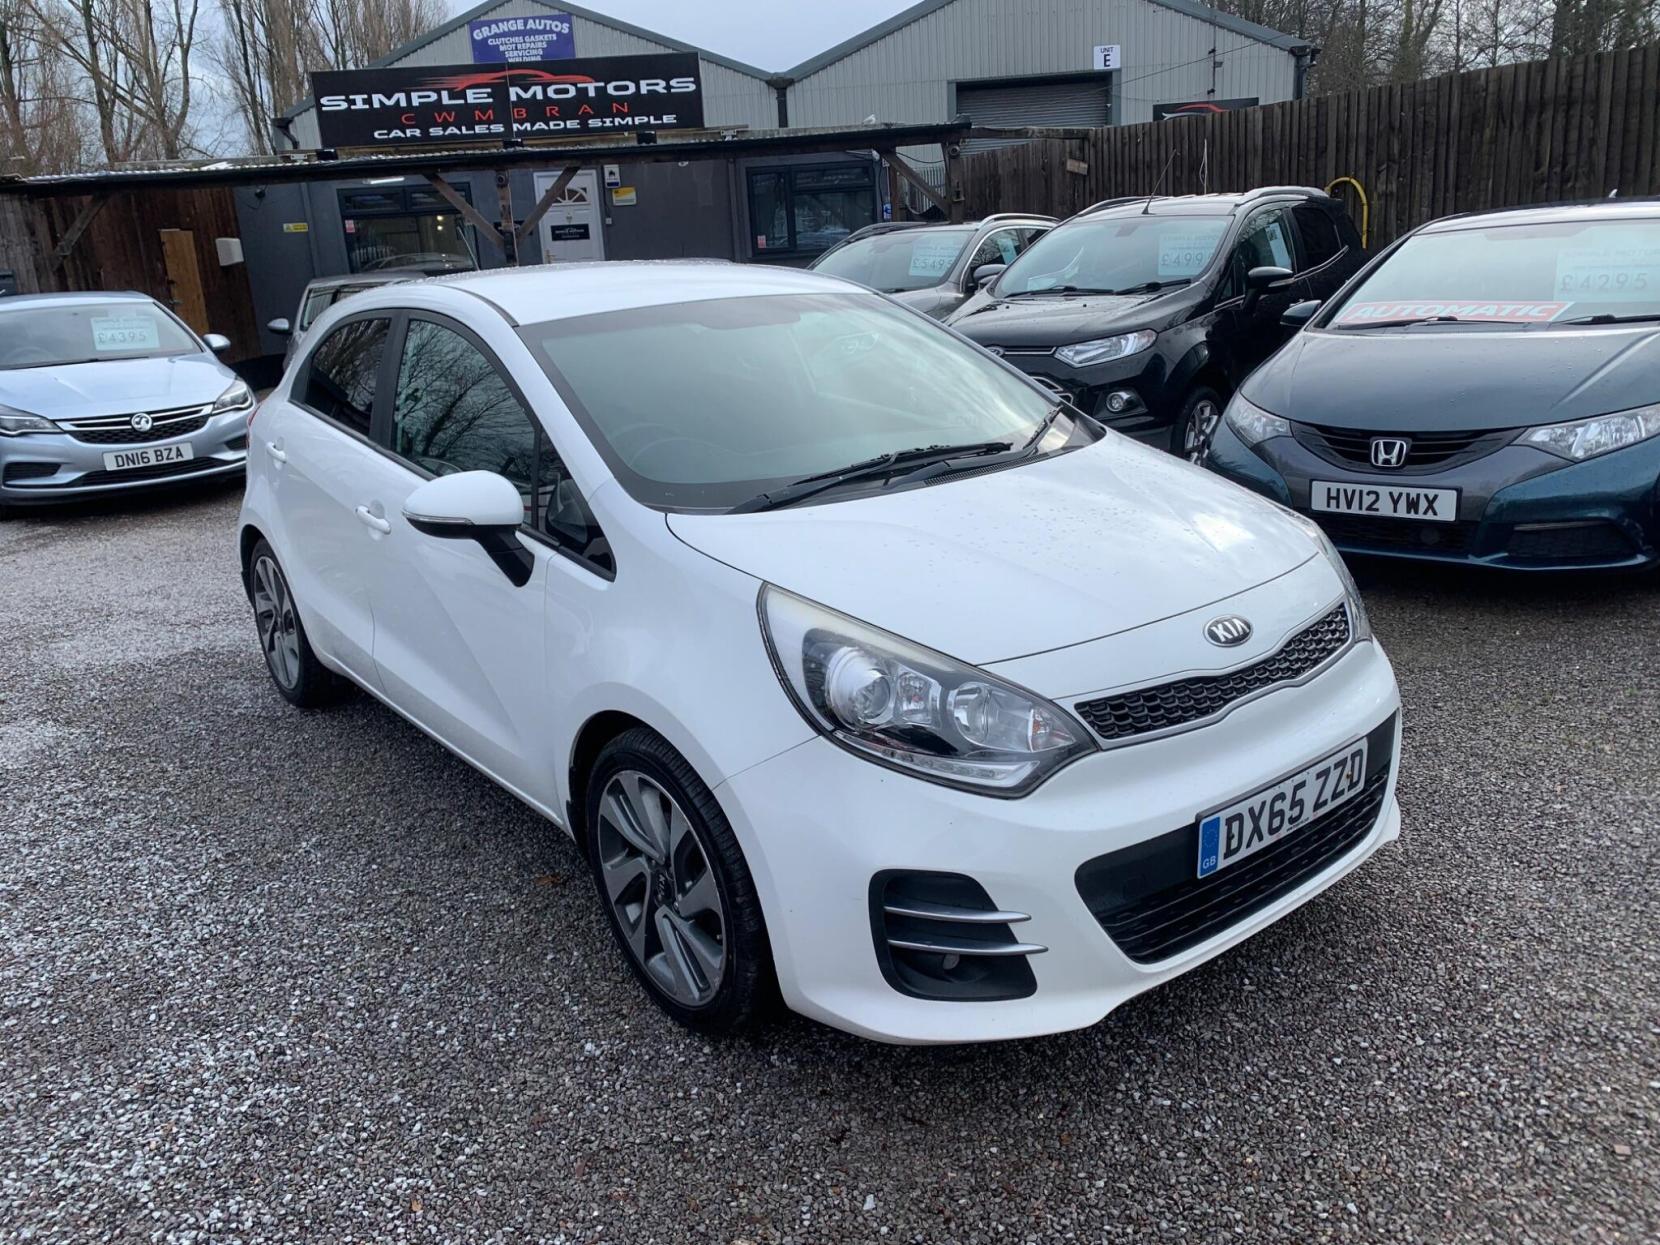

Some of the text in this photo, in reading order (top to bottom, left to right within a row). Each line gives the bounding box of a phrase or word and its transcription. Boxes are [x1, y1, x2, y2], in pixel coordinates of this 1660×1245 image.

[473, 18, 570, 40] GRANGE AUTOS
[487, 33, 557, 45] CLUTCHES GASKETS
[499, 41, 548, 52] MOT REPAIRS
[504, 48, 543, 58] SERVICING
[1100, 46, 1114, 54] UNIT
[1103, 53, 1111, 67] E
[319, 77, 697, 111] SIMPLE MOTORS
[373, 114, 678, 139] CAR SALES MADE SIMPLE
[1160, 252, 1214, 267] £499
[1559, 272, 1649, 293] £4295
[1352, 303, 1558, 319] AUTOMATIC
[97, 331, 147, 345] £4395
[114, 446, 185, 468] DN16 BZA
[1326, 487, 1439, 516] HV12 YWX
[1210, 618, 1250, 642] KIA
[1222, 748, 1364, 861] DX65 ZZD
[1202, 855, 1217, 870] GB
